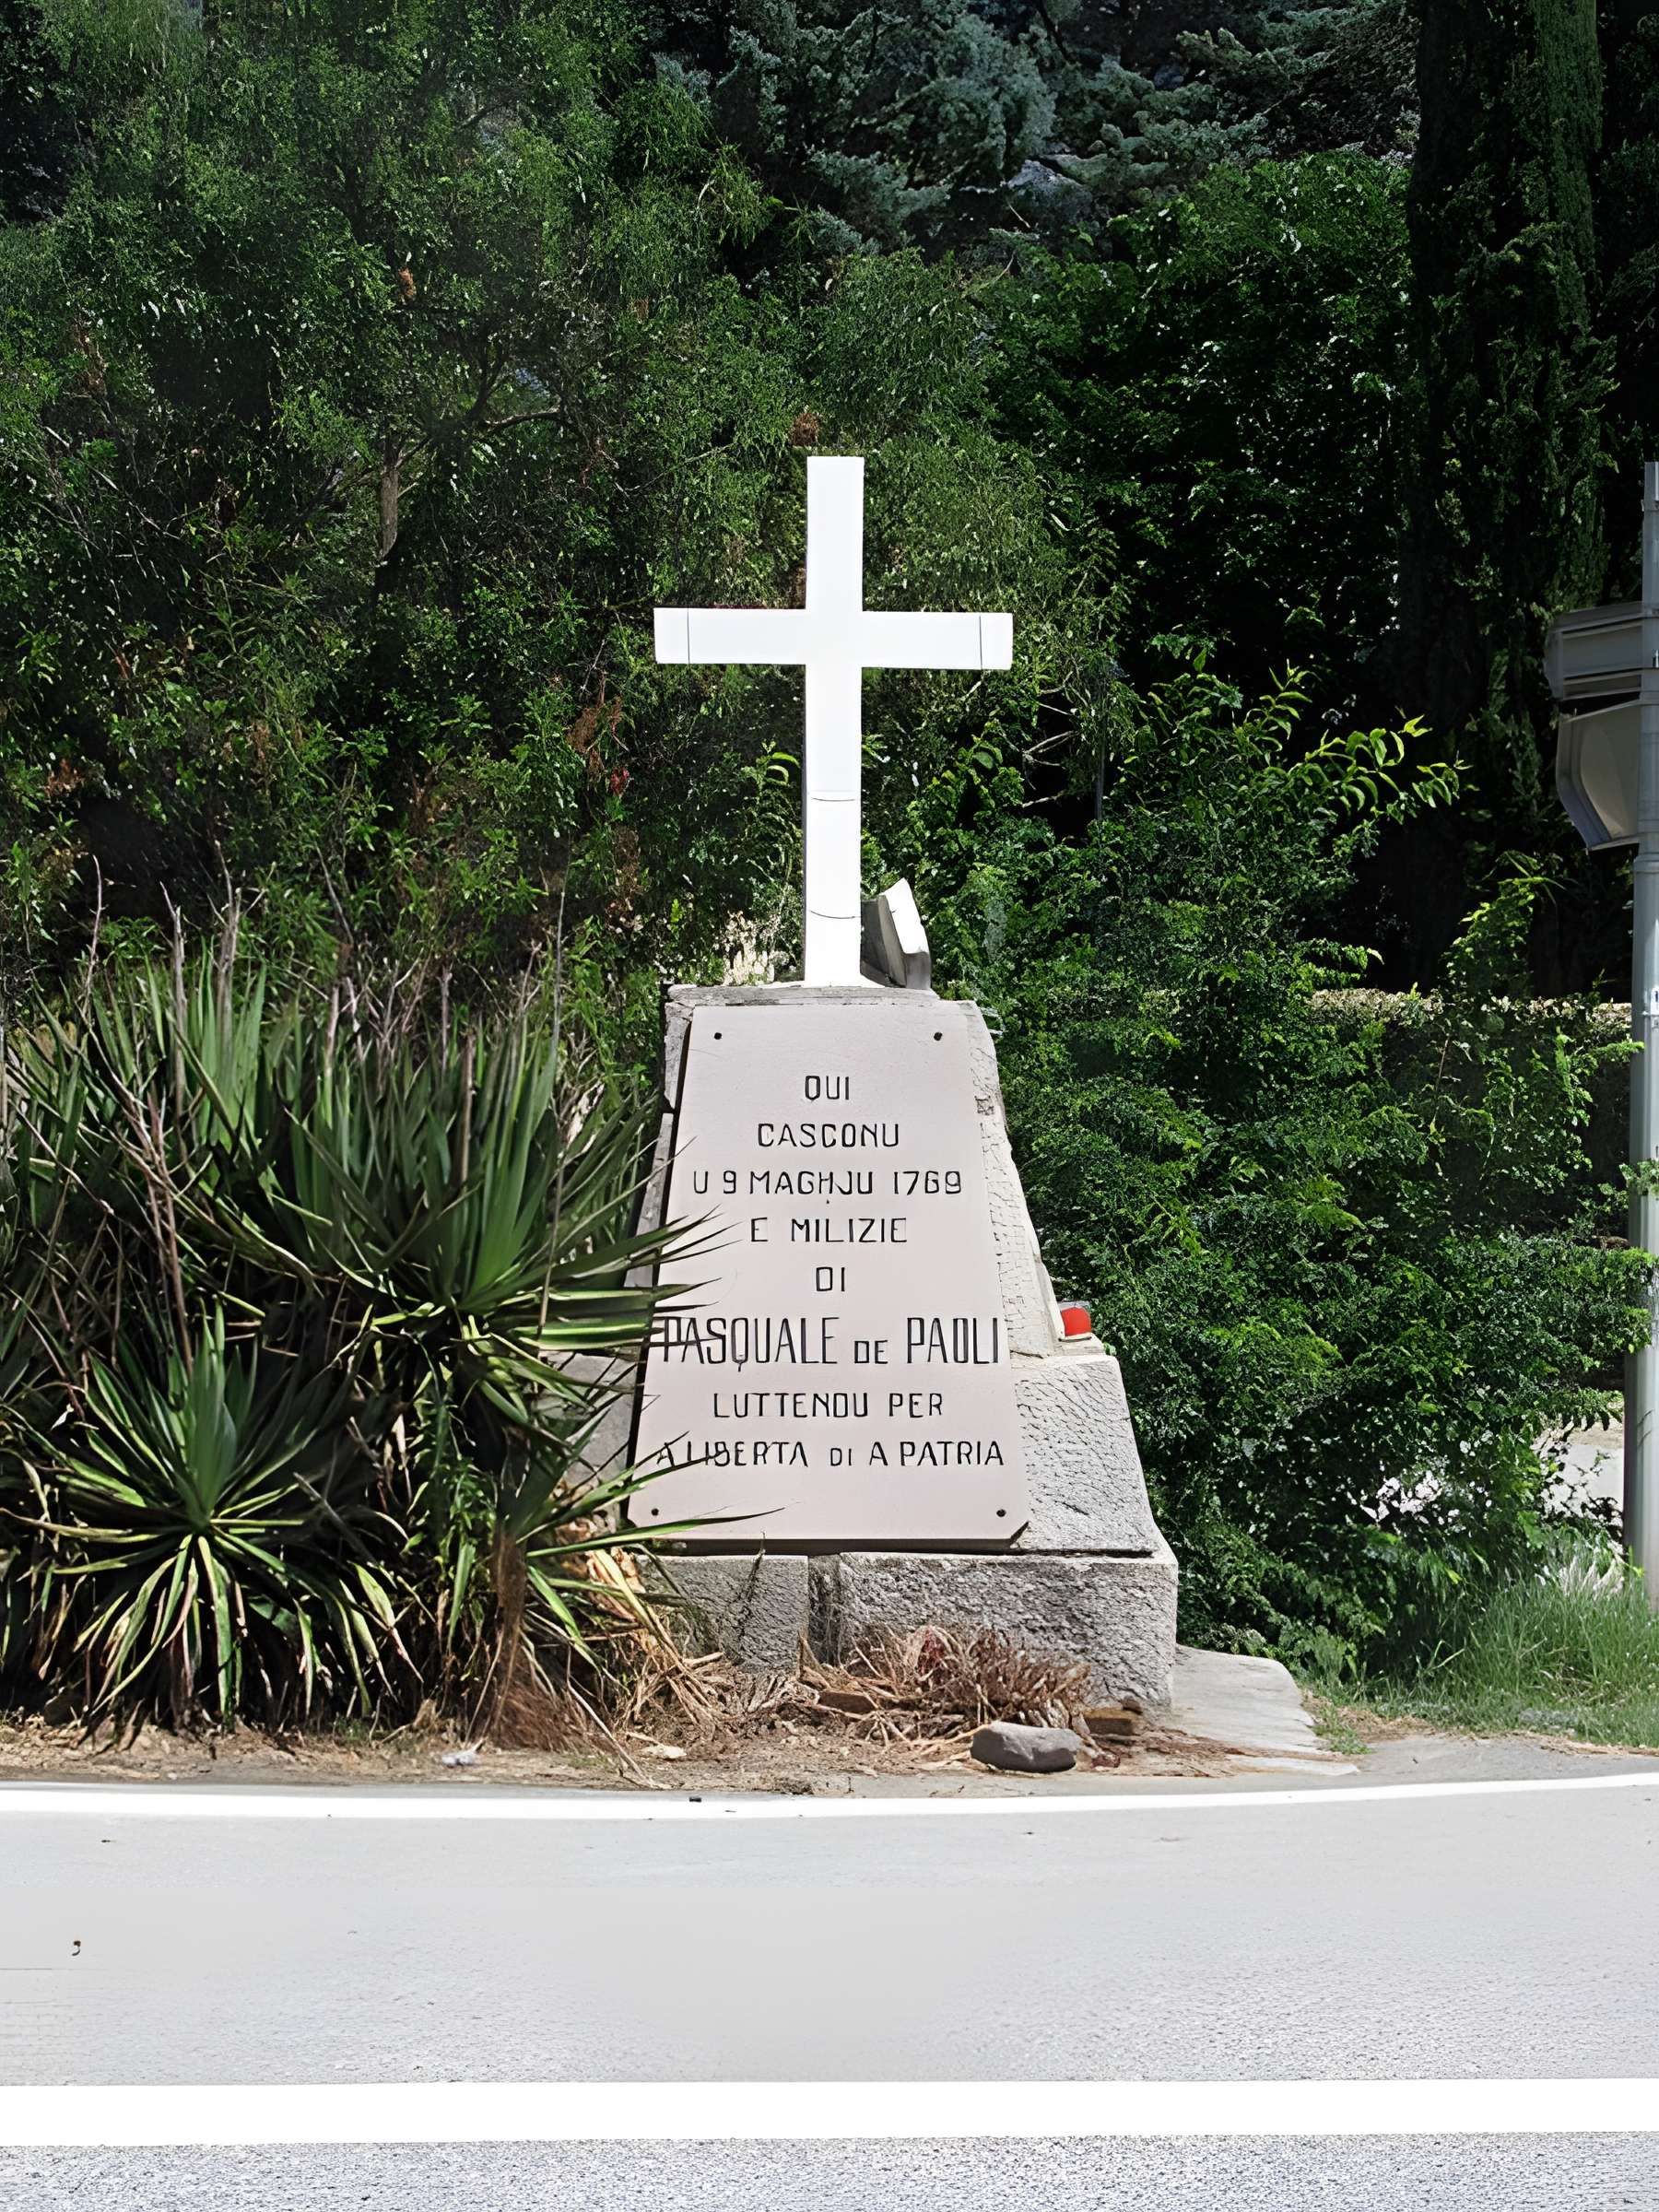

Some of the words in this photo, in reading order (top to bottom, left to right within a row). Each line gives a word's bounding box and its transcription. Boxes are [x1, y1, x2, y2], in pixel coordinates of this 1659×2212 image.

[805, 1075, 850, 1102] QUI
[758, 1123, 900, 1148] CASCONU
[693, 1170, 709, 1194] U
[723, 1170, 737, 1194] 9
[749, 1170, 874, 1195] MAGHJU
[893, 1170, 962, 1196] 1769
[750, 1217, 769, 1242] E
[791, 1217, 908, 1243] MILIZIE
[815, 1266, 845, 1292] DI
[663, 1316, 840, 1372] PASQUALE
[853, 1340, 891, 1365] DE
[906, 1317, 999, 1365] PAOLI
[713, 1392, 868, 1418] LUTTENDU
[888, 1393, 943, 1418] PER
[656, 1441, 676, 1467] A
[830, 1447, 853, 1467] DI
[868, 1441, 888, 1466] A
[900, 1441, 1005, 1466] PATRIA
